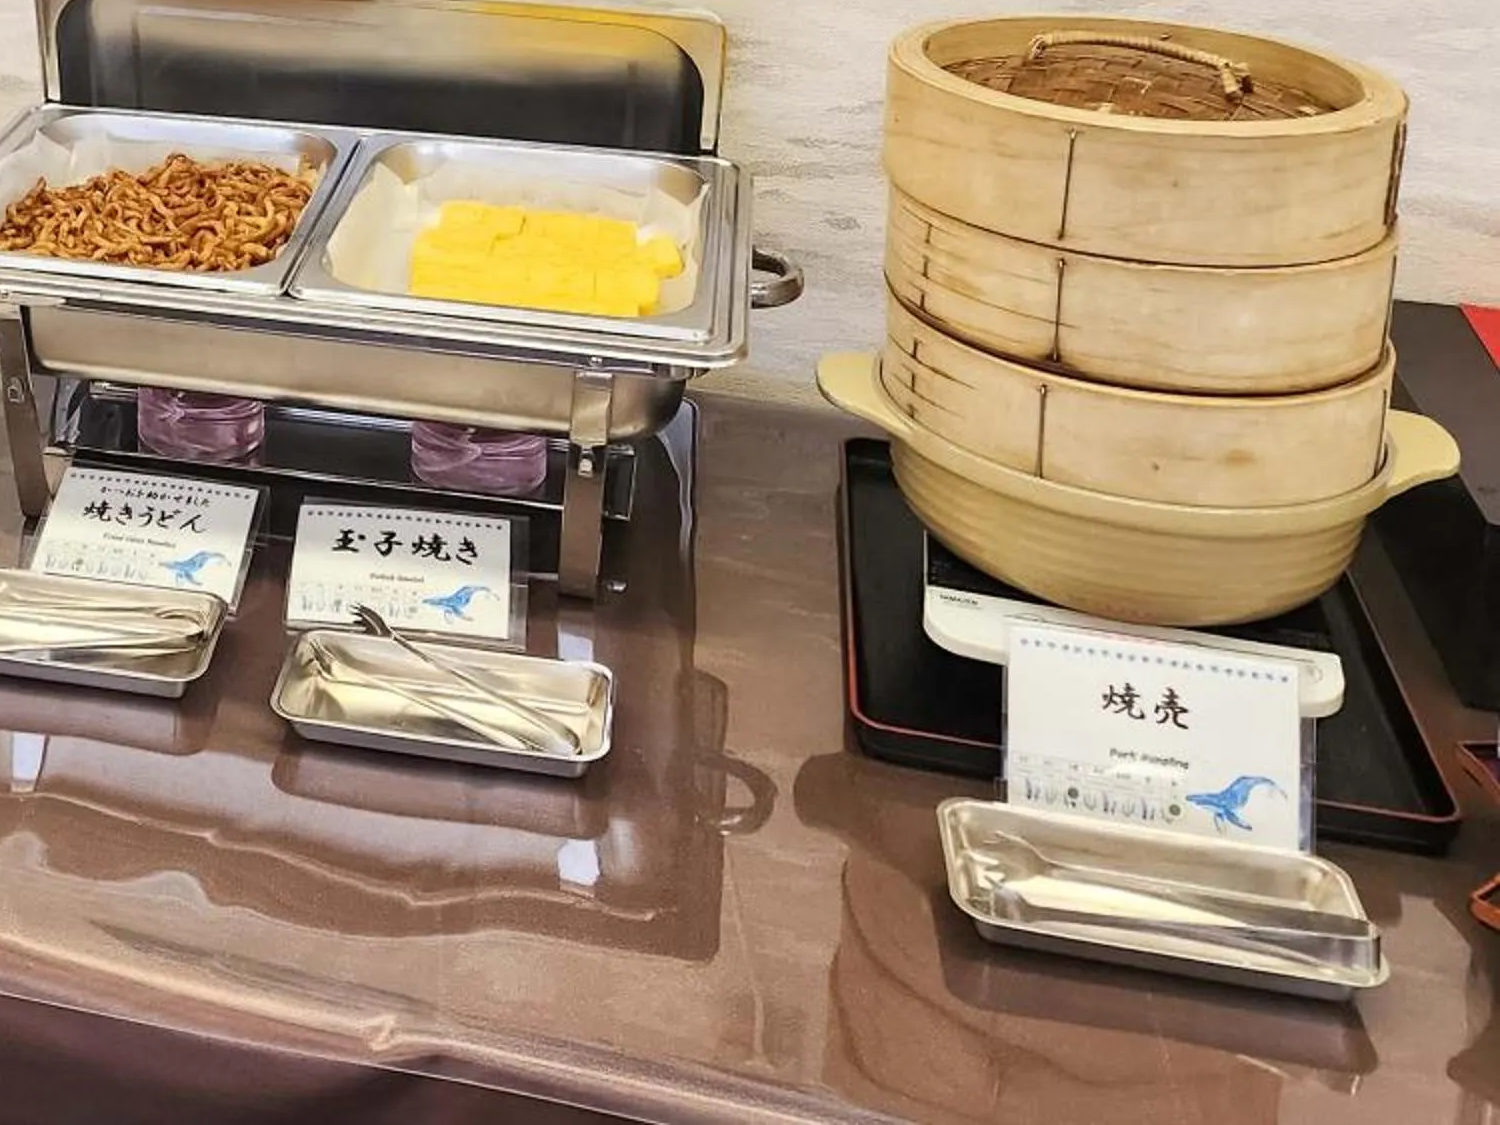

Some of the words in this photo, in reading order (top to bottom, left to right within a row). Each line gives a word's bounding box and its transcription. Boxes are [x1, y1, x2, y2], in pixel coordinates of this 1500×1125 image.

[83, 499, 206, 533] 焼きうどん
[332, 528, 478, 565] 玉子焼き
[1102, 682, 1189, 730] 焼売
